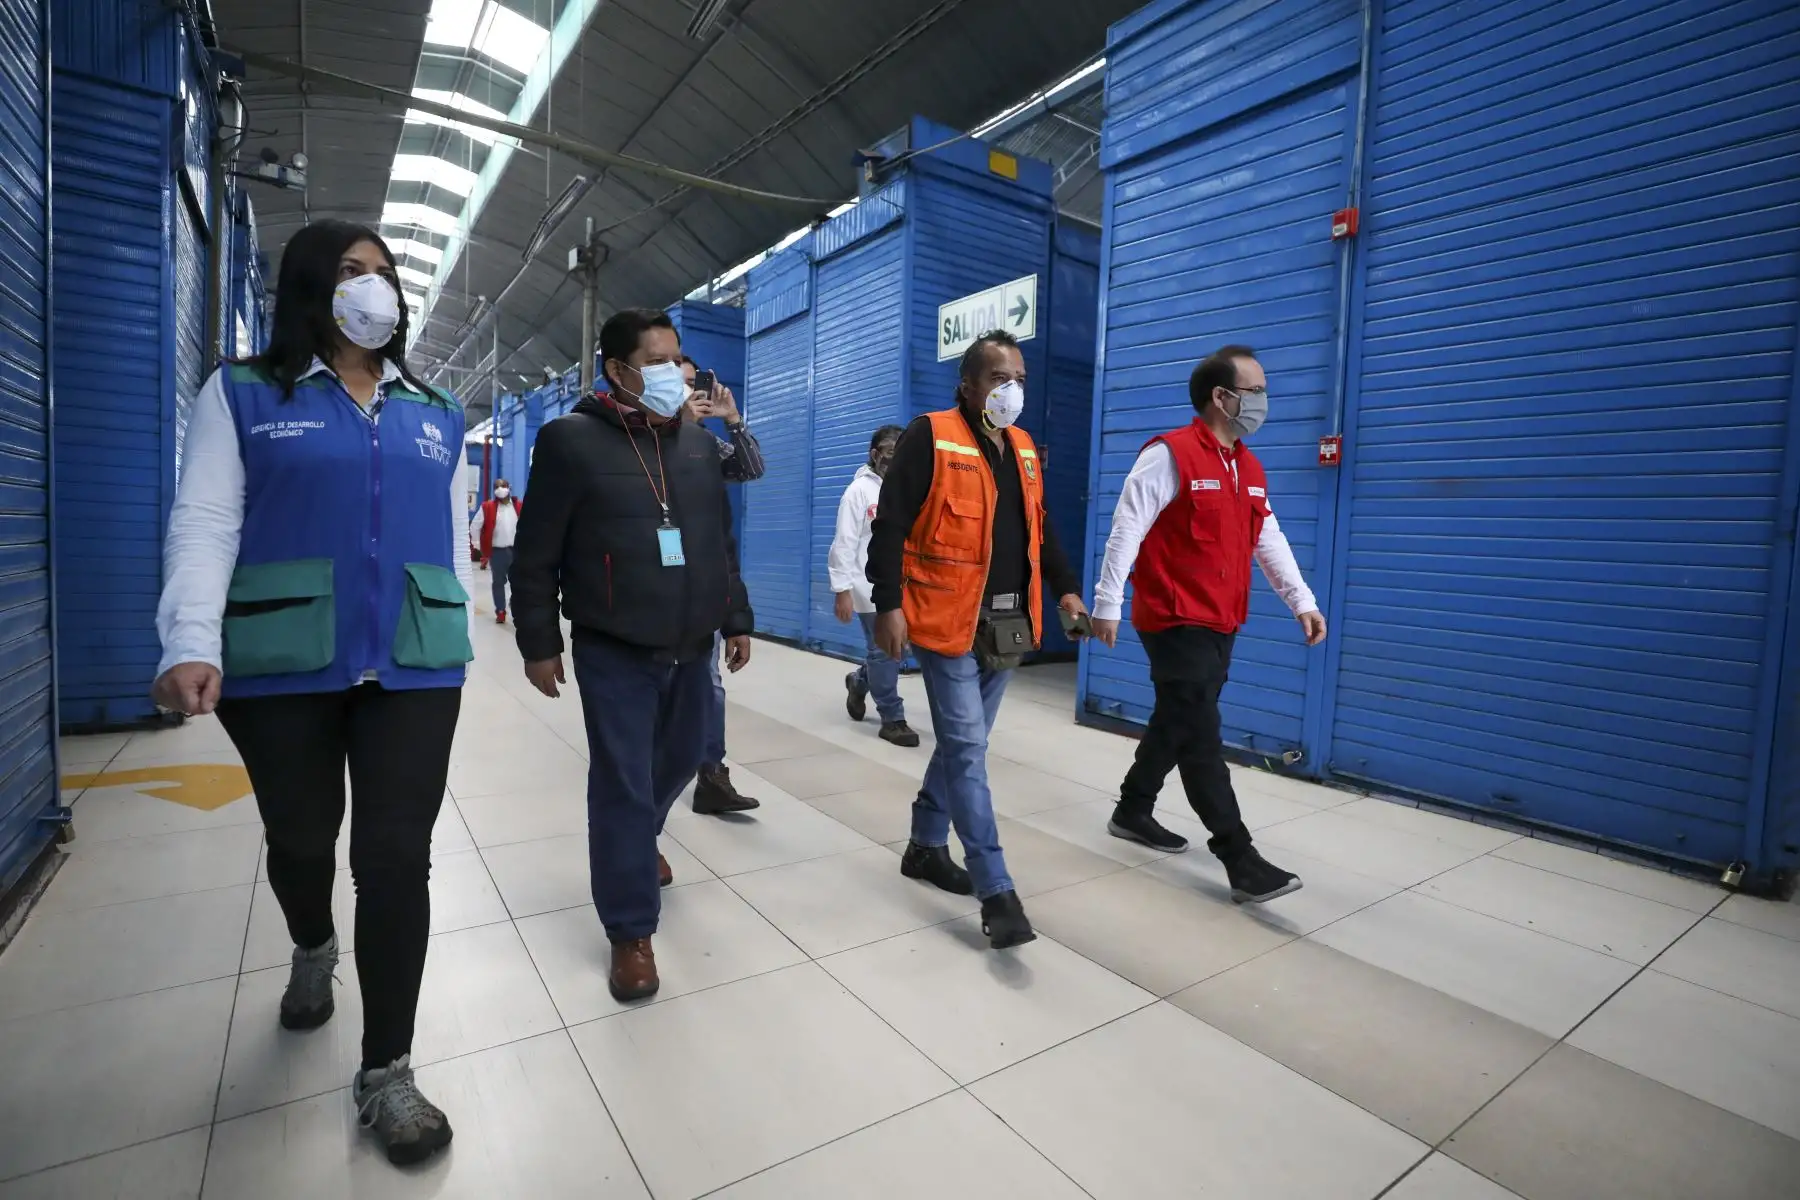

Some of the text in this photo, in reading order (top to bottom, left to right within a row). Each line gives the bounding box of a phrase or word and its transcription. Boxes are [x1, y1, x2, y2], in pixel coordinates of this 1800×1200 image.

[943, 302, 997, 345] SALIDA
[277, 421, 286, 429] DE
[287, 420, 325, 428] DESARROLLO
[947, 460, 979, 473] PRESIDENTE
